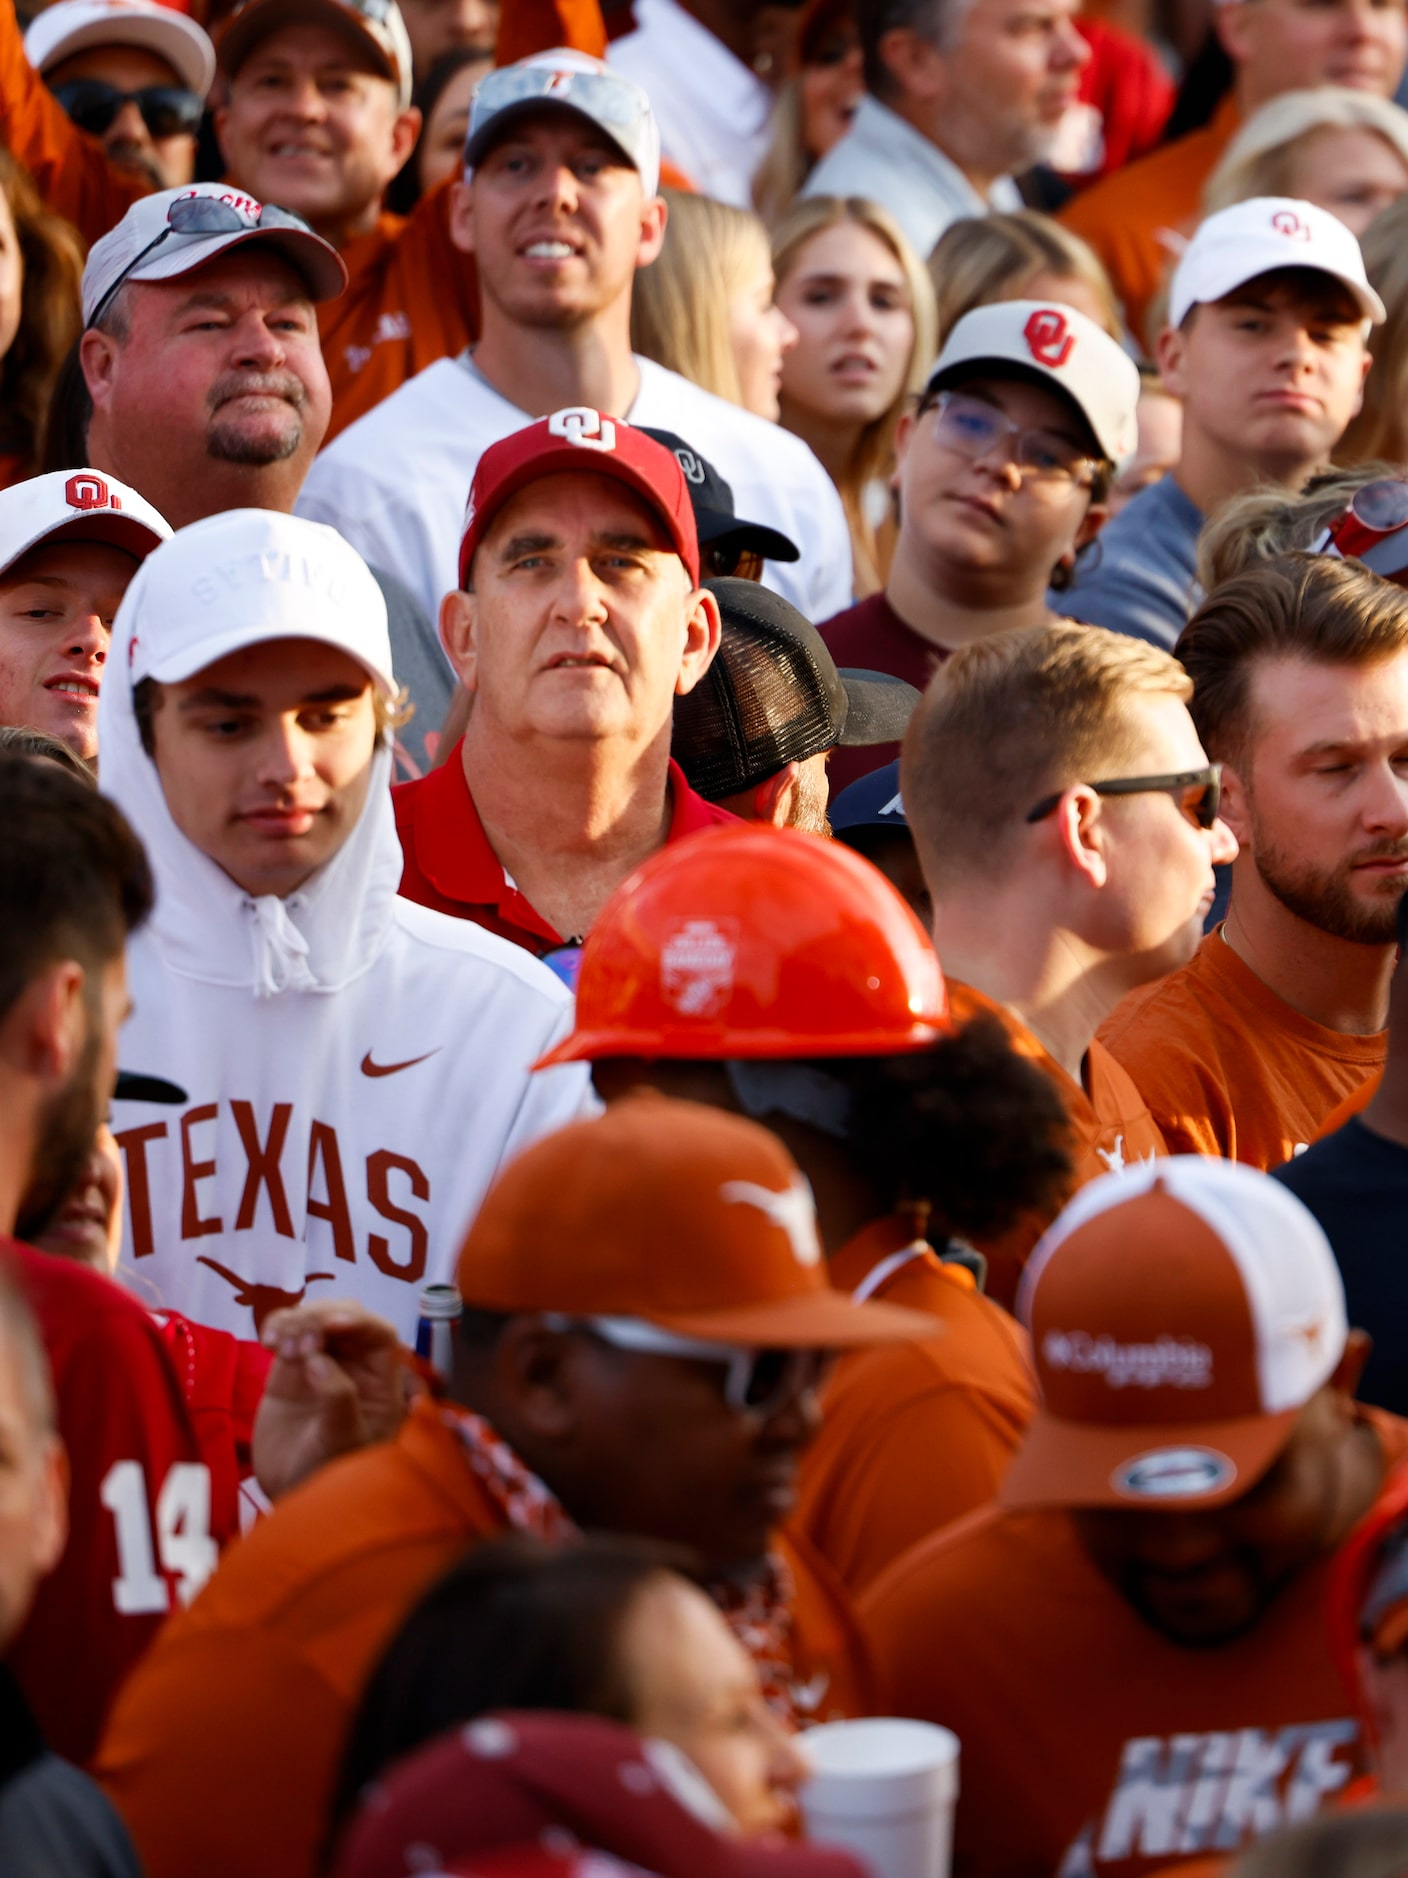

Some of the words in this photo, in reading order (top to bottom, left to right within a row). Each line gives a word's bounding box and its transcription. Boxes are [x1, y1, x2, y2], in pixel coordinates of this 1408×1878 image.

[1023, 309, 1075, 368] OU
[548, 406, 616, 452] OU
[674, 449, 705, 484] OU
[113, 1098, 430, 1284] TEXAS
[99, 1461, 220, 1616] 14
[1097, 1715, 1360, 1862] NIKE
